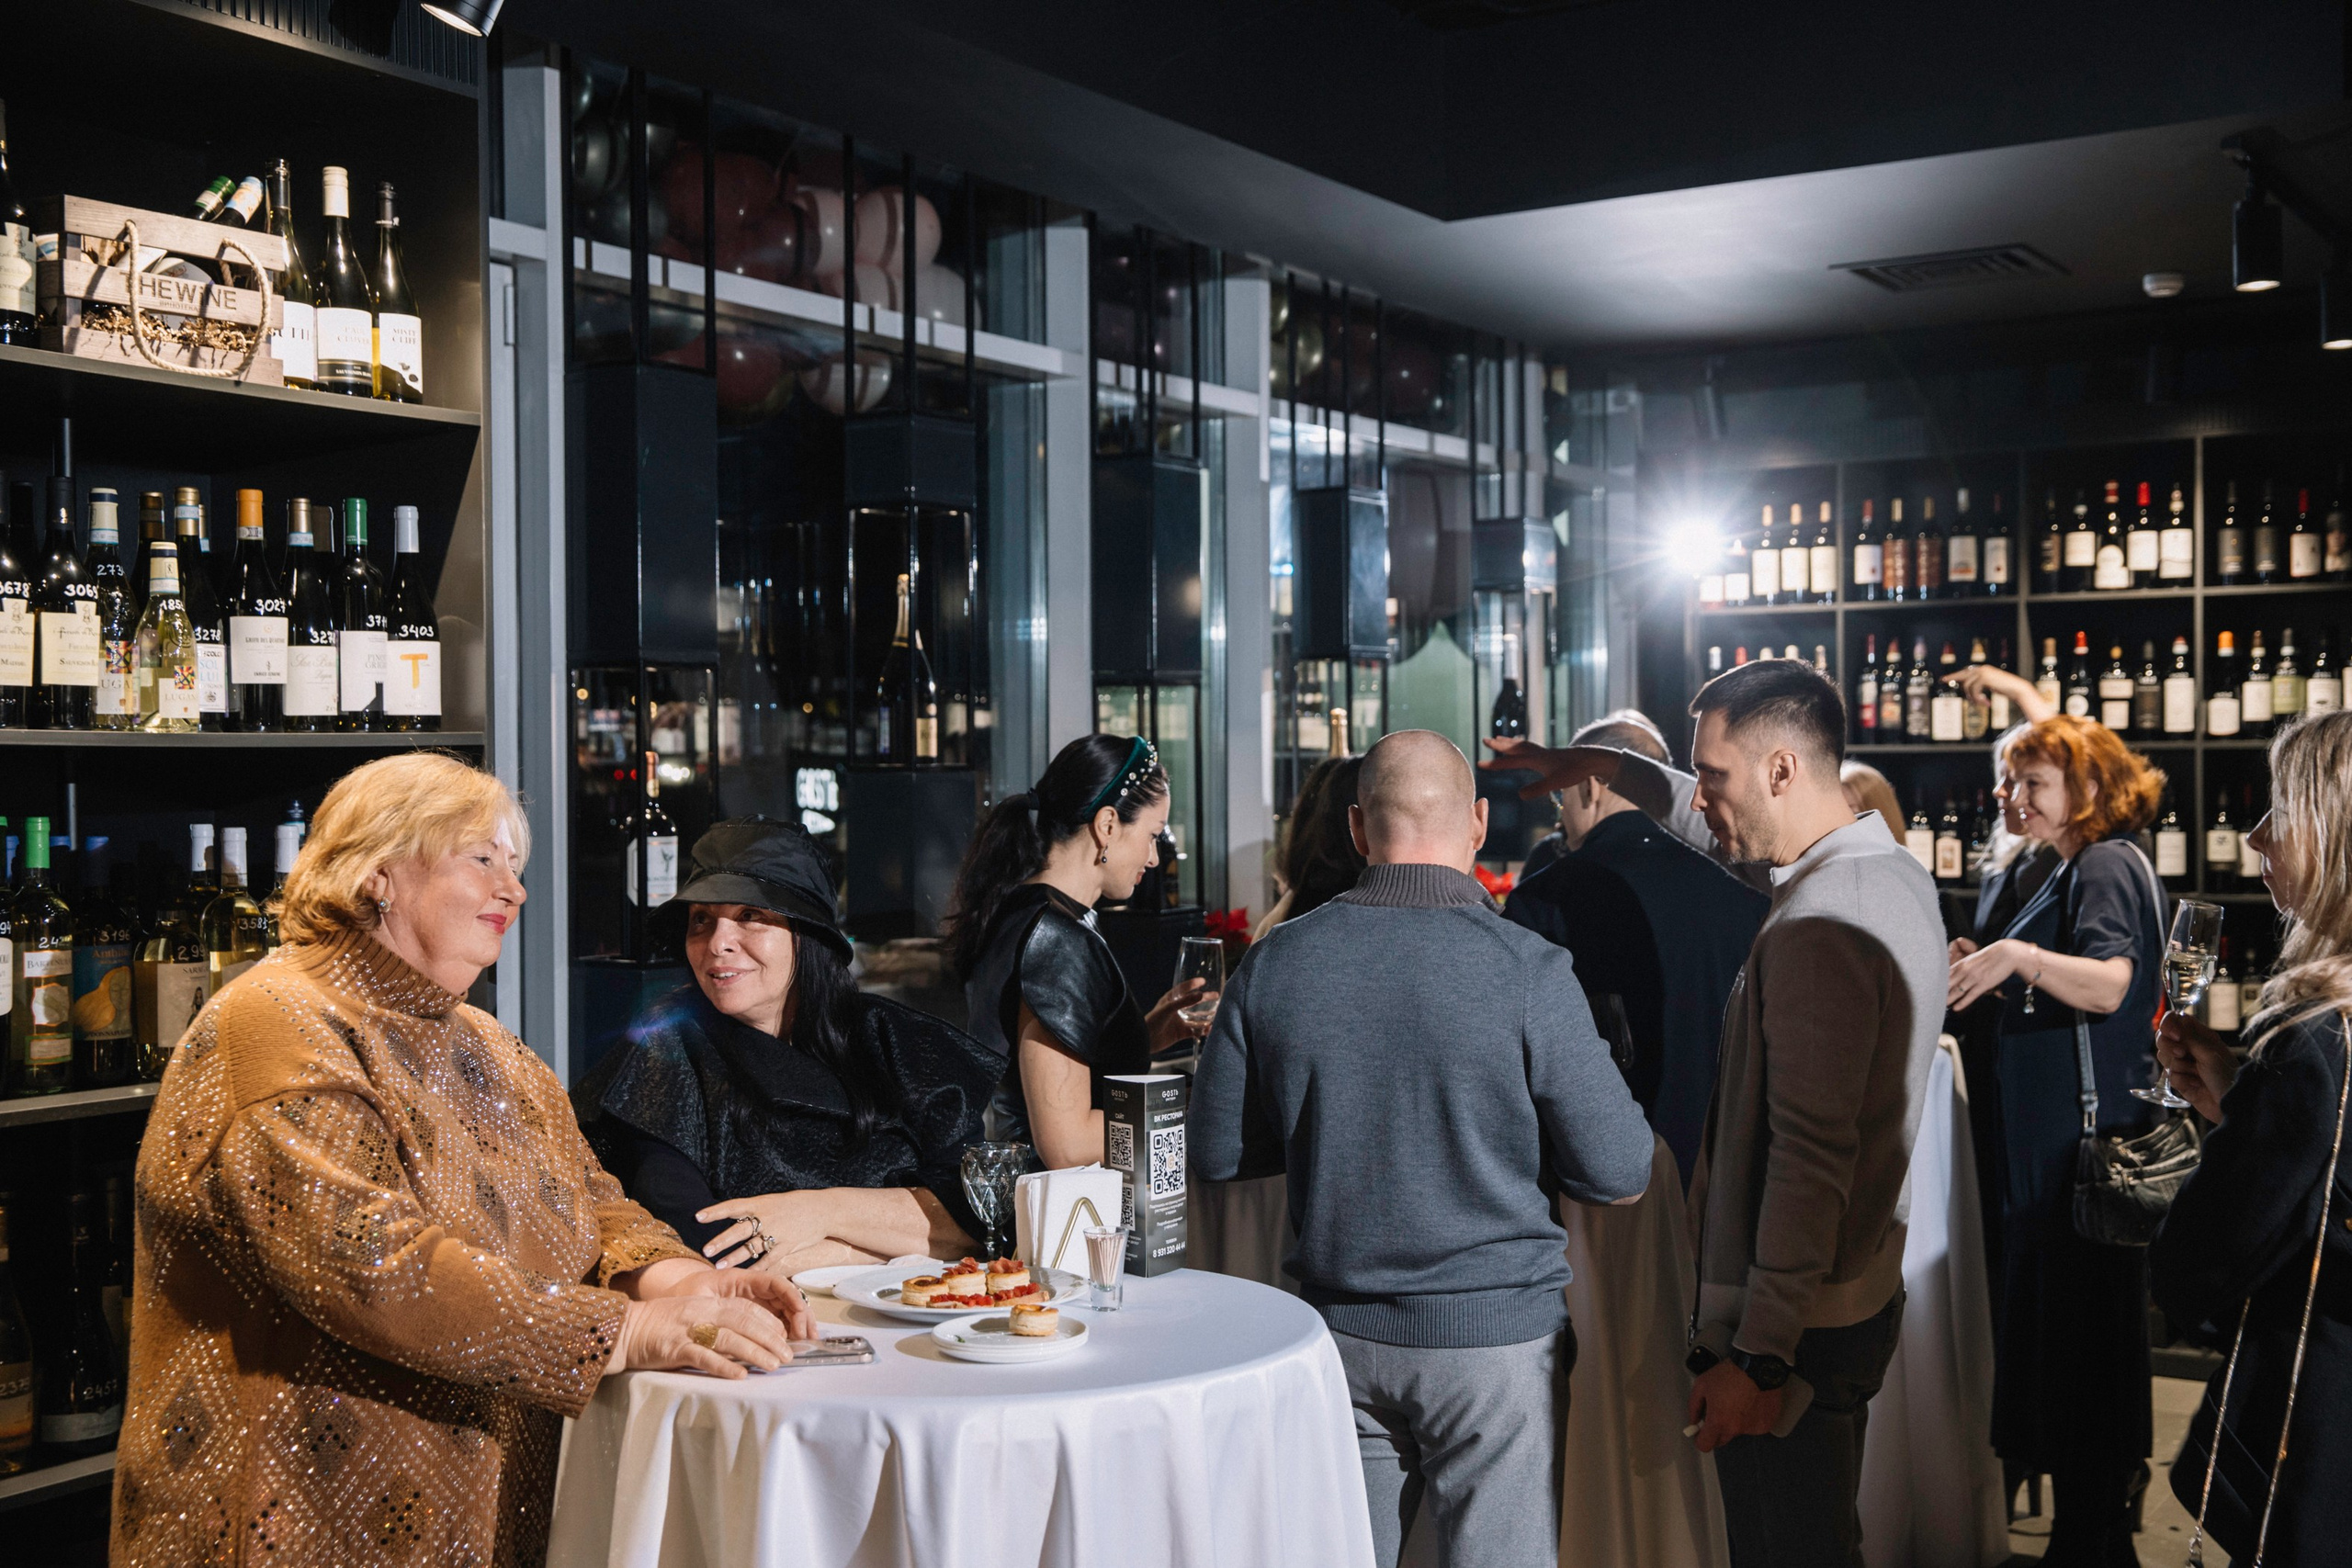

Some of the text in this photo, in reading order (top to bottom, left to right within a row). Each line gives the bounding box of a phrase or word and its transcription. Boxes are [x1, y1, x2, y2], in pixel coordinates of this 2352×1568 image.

[392, 327, 417, 337] MISTY
[96, 564, 123, 577] 273
[399, 624, 435, 638] 3403
[400, 653, 429, 689] T
[101, 679, 130, 689] UGA
[239, 917, 268, 931] 3581
[1158, 1247, 1167, 1258] 931
[1166, 1244, 1175, 1255] 320
